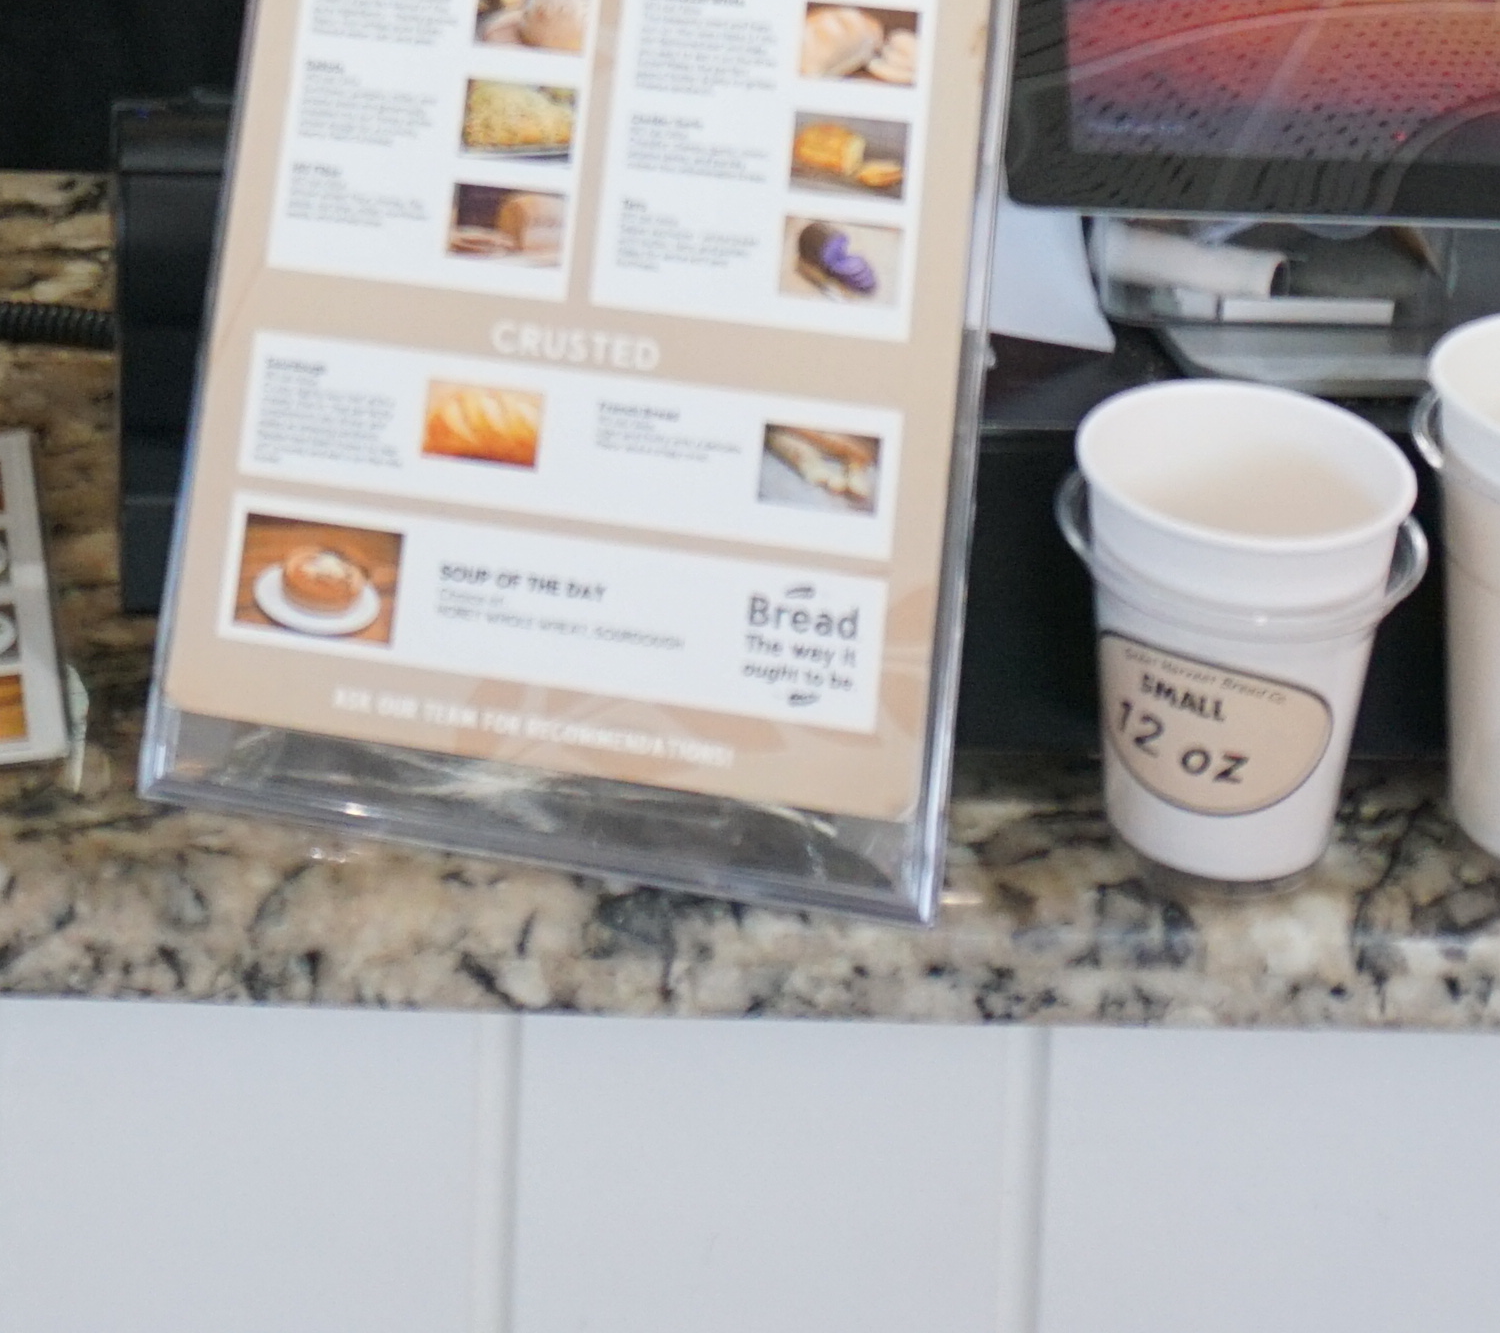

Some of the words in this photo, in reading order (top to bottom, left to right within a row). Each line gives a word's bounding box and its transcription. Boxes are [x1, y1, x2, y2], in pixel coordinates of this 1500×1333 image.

[489, 320, 661, 373] CRUSTED
[439, 563, 495, 587] SOUP
[497, 571, 522, 591] OF
[528, 574, 562, 598] THE
[565, 580, 608, 603] DAY
[747, 591, 860, 642] Bread
[741, 660, 801, 687] ought
[803, 669, 826, 688] to
[744, 633, 783, 659] The
[792, 643, 836, 670] way
[1139, 673, 1228, 724] SMALL
[1118, 699, 1166, 759] 12
